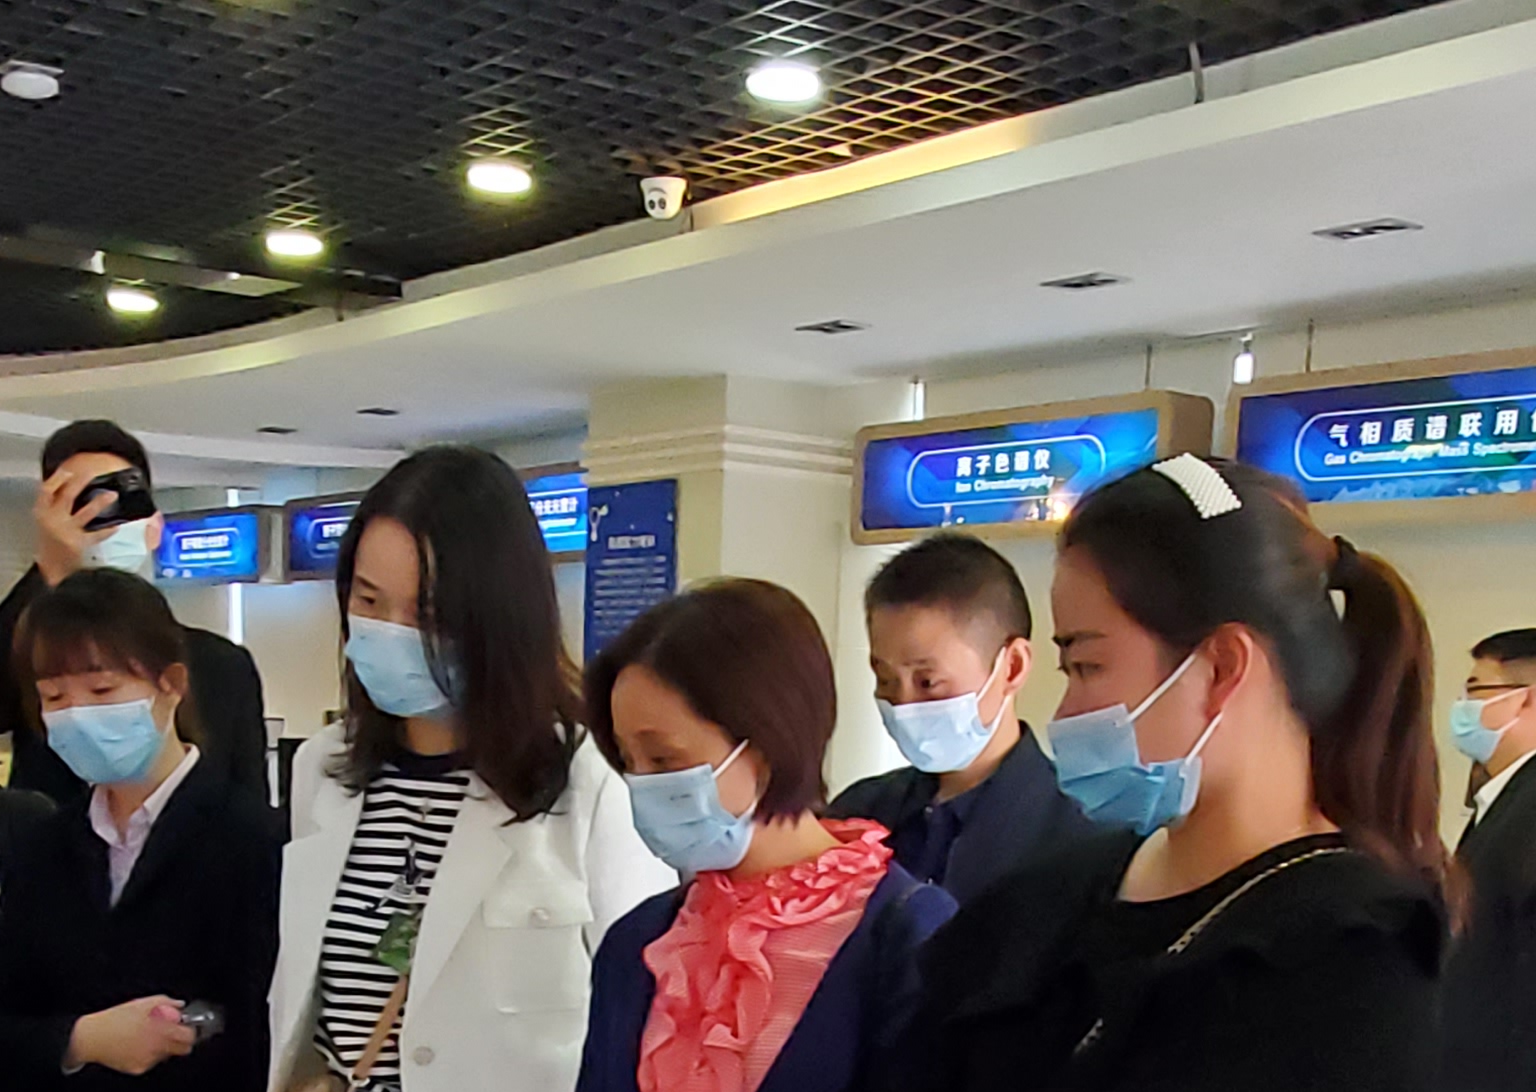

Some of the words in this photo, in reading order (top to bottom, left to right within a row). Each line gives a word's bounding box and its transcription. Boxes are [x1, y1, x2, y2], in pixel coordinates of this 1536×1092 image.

[956, 449, 1051, 478] 离子色谱仪
